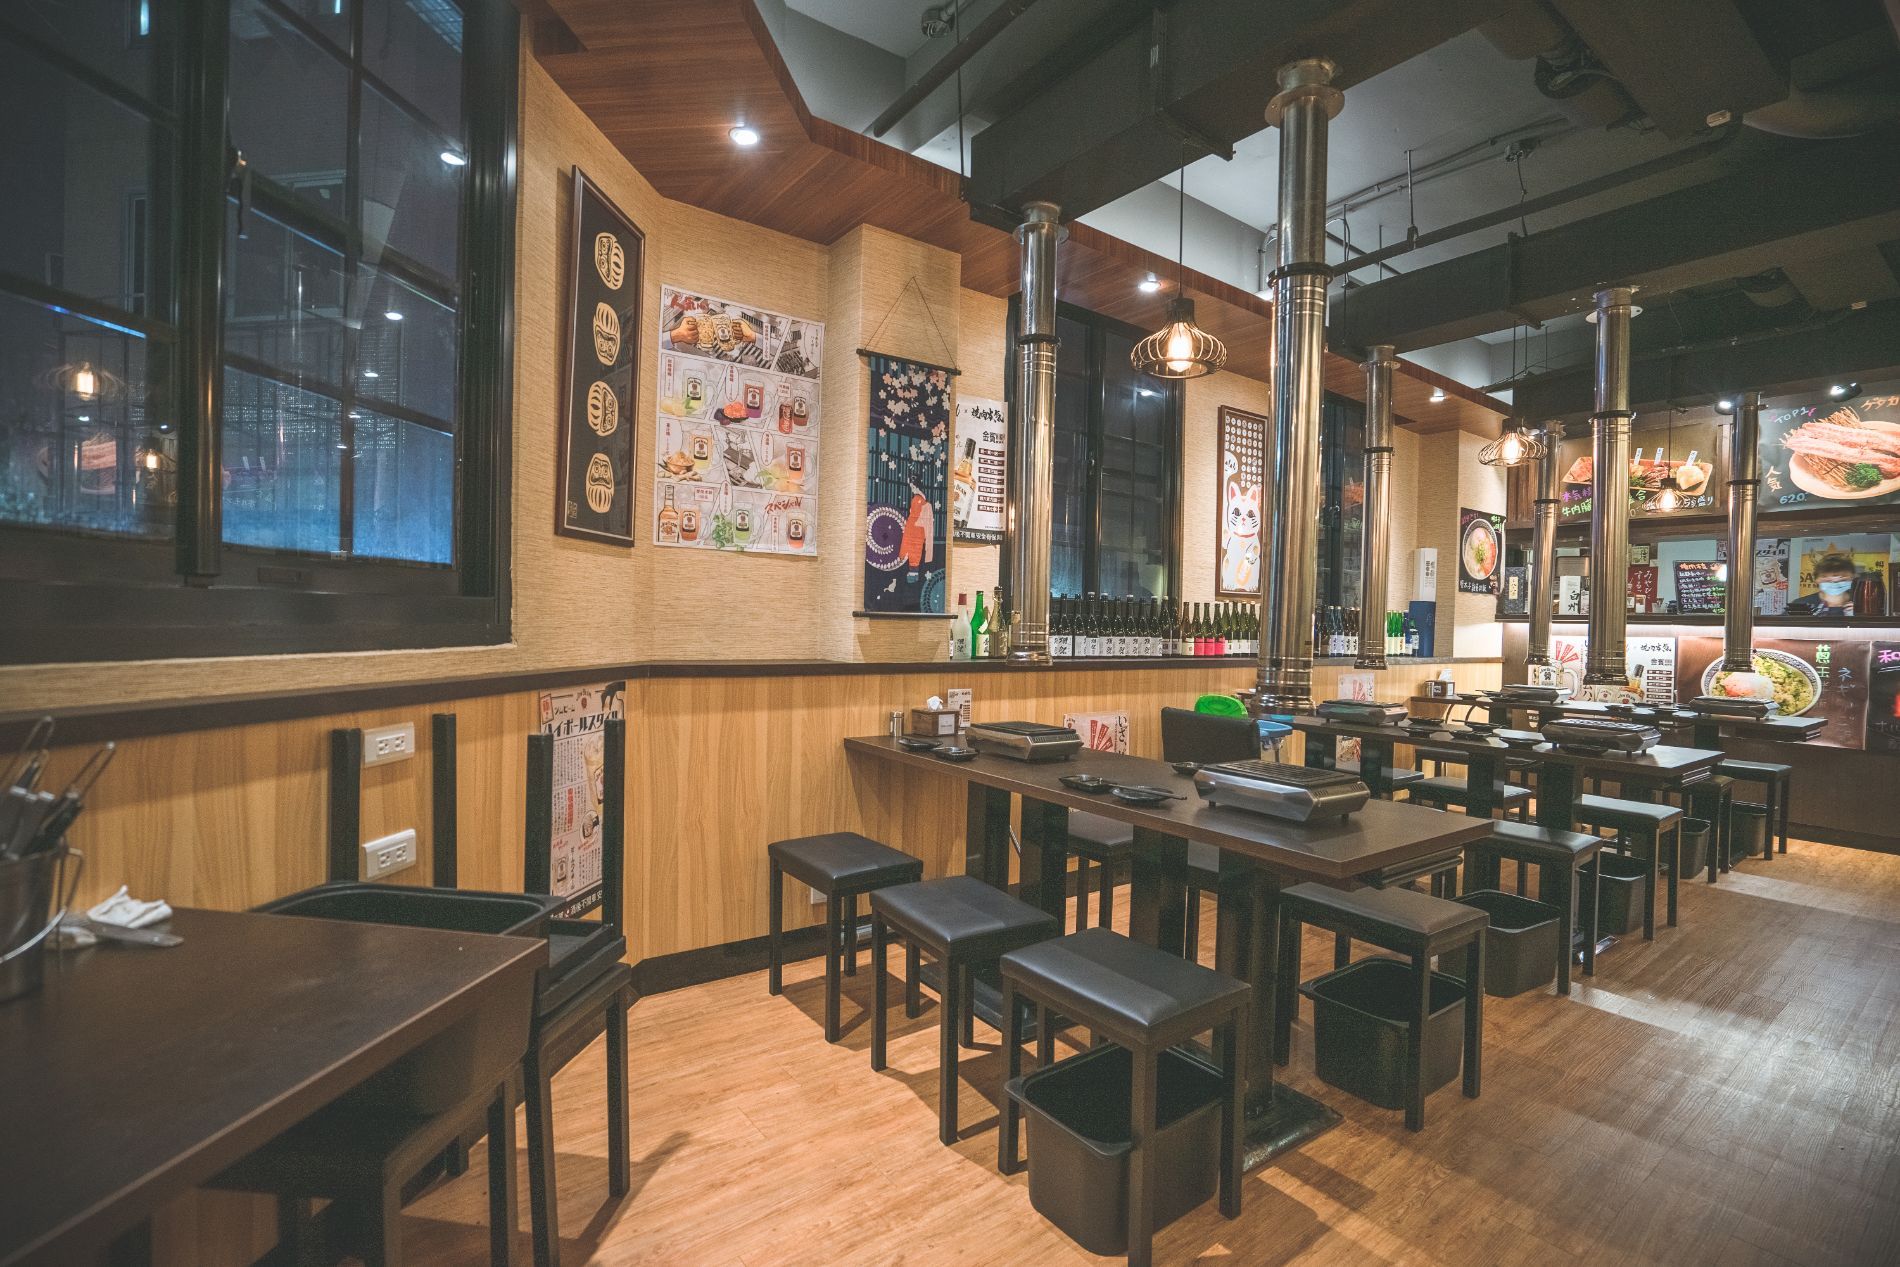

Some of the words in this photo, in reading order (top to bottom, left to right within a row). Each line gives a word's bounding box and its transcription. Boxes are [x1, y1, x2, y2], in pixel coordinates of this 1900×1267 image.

[765, 496, 803, 515] スペシャル
